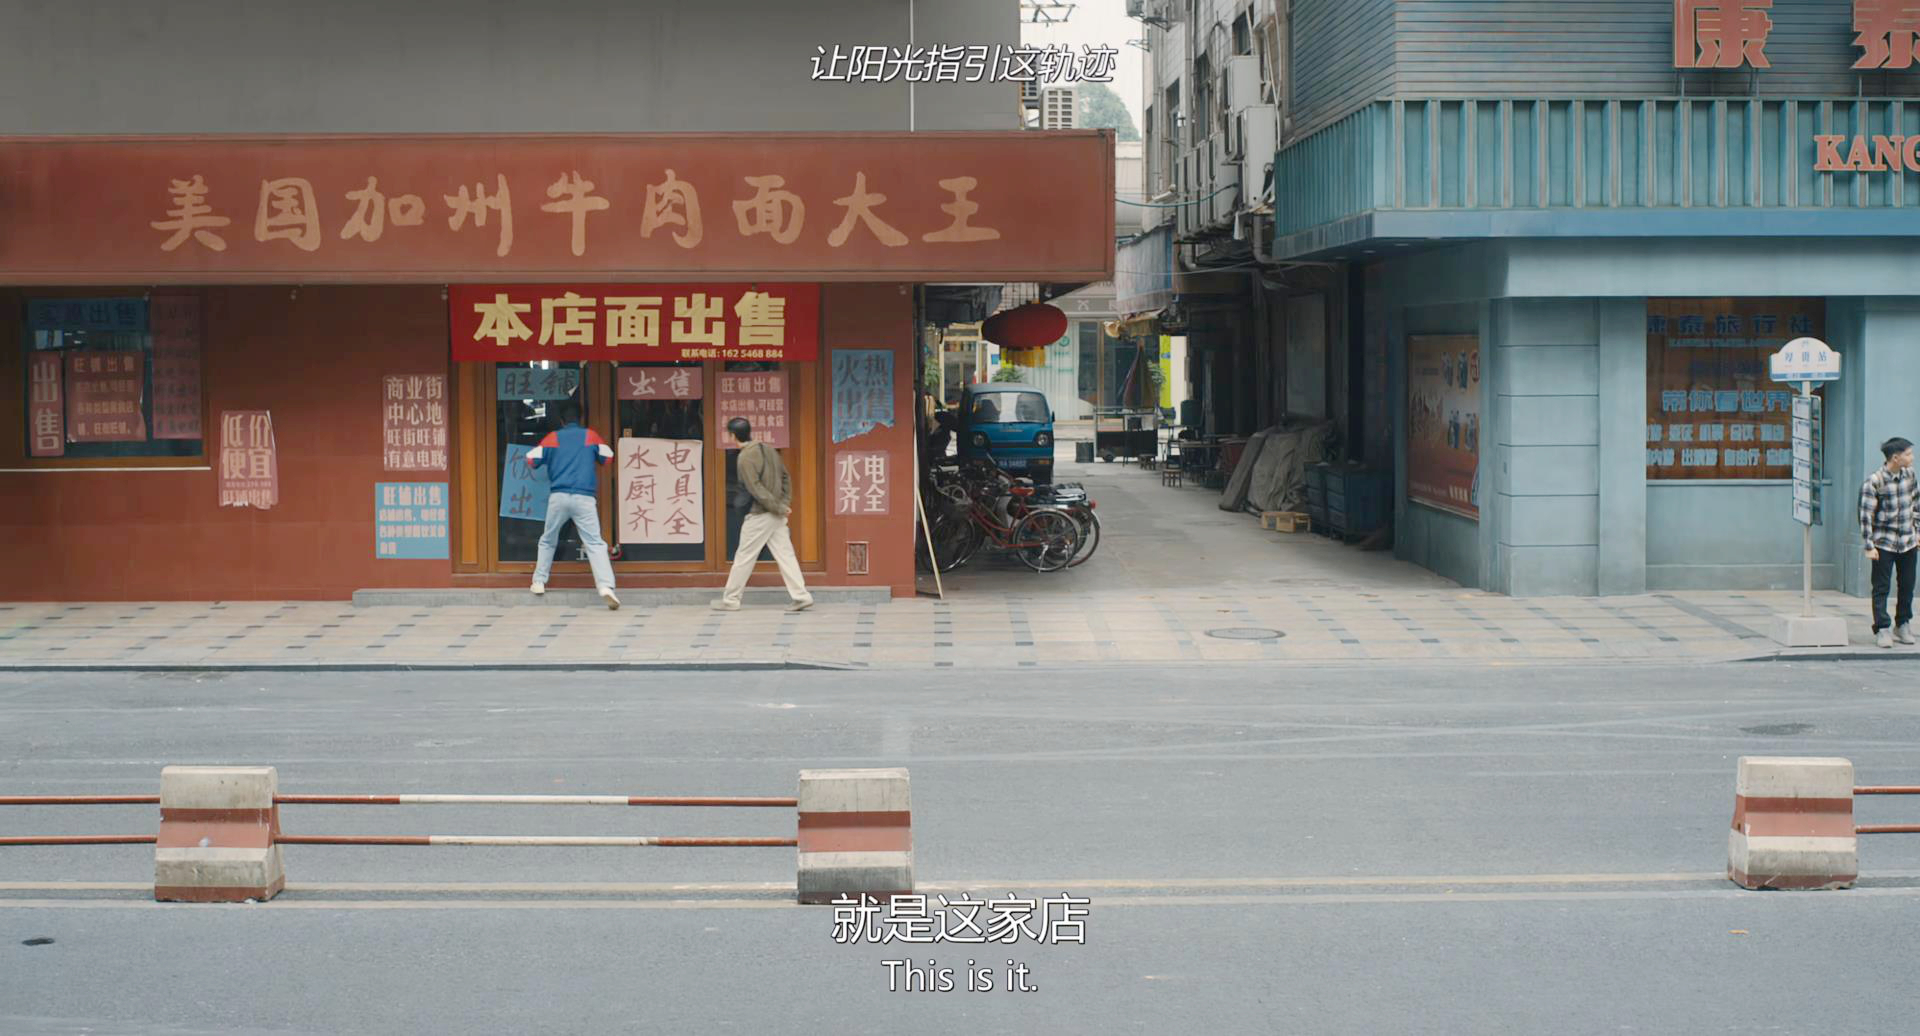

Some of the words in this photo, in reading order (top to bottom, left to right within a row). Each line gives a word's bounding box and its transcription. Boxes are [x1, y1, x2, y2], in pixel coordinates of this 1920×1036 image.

[150, 171, 1001, 257] 美国加州牛肉面大王
[473, 291, 786, 347] 本店面出售
[386, 376, 443, 399] 商业街
[628, 369, 691, 396] 出售
[33, 361, 60, 450] 出售
[388, 401, 443, 425] 中心地
[223, 414, 270, 447] 低价
[223, 448, 272, 479] 便宜
[624, 442, 696, 472] 水电
[838, 455, 886, 484] 水电
[625, 473, 697, 504] 厨具
[838, 481, 887, 513] 齐全
[627, 505, 698, 537] 齐全
